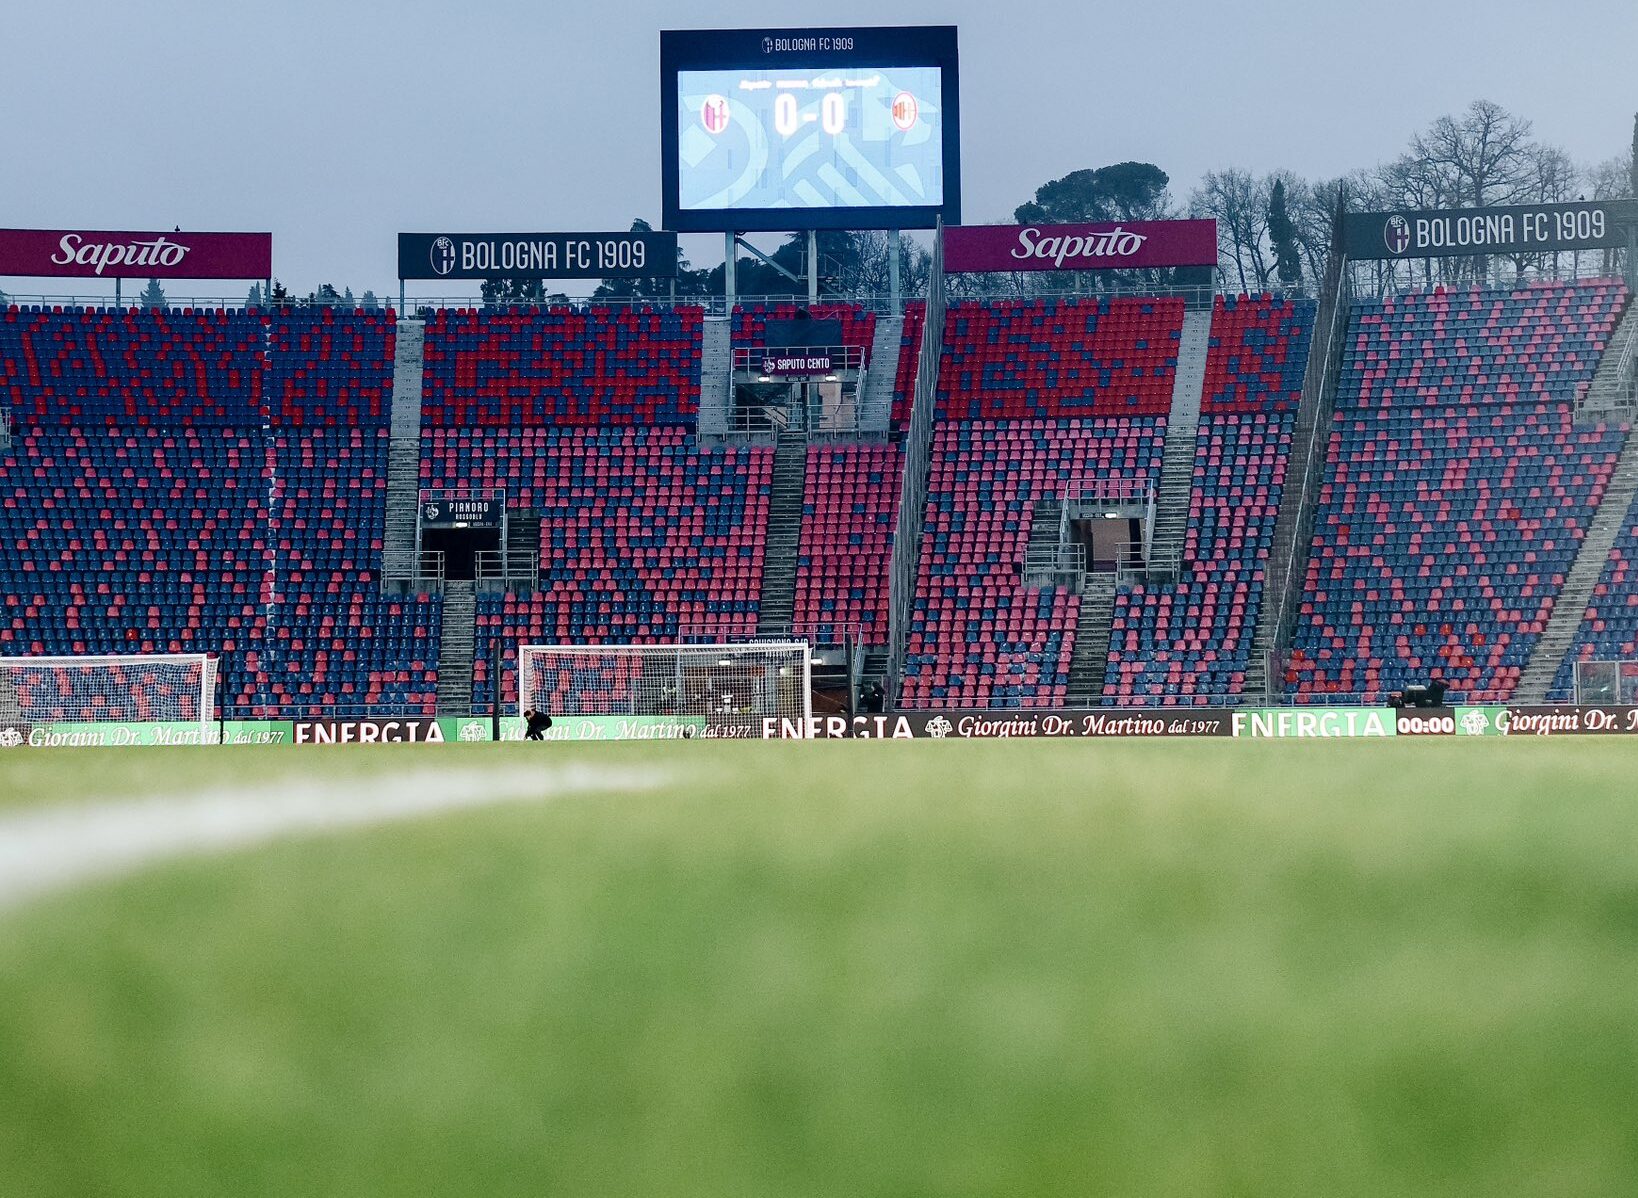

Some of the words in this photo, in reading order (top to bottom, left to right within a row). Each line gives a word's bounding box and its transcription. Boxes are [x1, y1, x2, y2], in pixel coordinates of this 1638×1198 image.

[775, 38, 816, 51] BOLOGNA
[819, 37, 830, 50] FC
[832, 37, 854, 50] 1909
[1416, 214, 1514, 248] BOLOGNA
[1523, 212, 1549, 242] FC
[1553, 209, 1606, 240] 1909
[50, 233, 191, 275] Saputo
[462, 241, 557, 270] BOLOGNA
[566, 240, 591, 269] FC
[597, 240, 646, 268] 1909
[1010, 226, 1148, 268] Saputo
[777, 358, 805, 370] SAPUTO
[807, 357, 830, 369] CENTO
[449, 502, 489, 513] PIANORO
[700, 724, 721, 738] dal
[722, 725, 751, 738] 1977
[957, 714, 1038, 738] Giorgini
[1042, 714, 1075, 735] Dr.
[1082, 713, 1164, 736] Martino
[1168, 719, 1188, 734] dal
[1190, 720, 1220, 734] 1977
[1397, 717, 1455, 734] 00:00
[1495, 708, 1579, 735] Giorgini
[1584, 709, 1618, 730] Dr.
[110, 727, 141, 745] Dr.
[233, 730, 251, 744] dal
[255, 731, 284, 744] 1977
